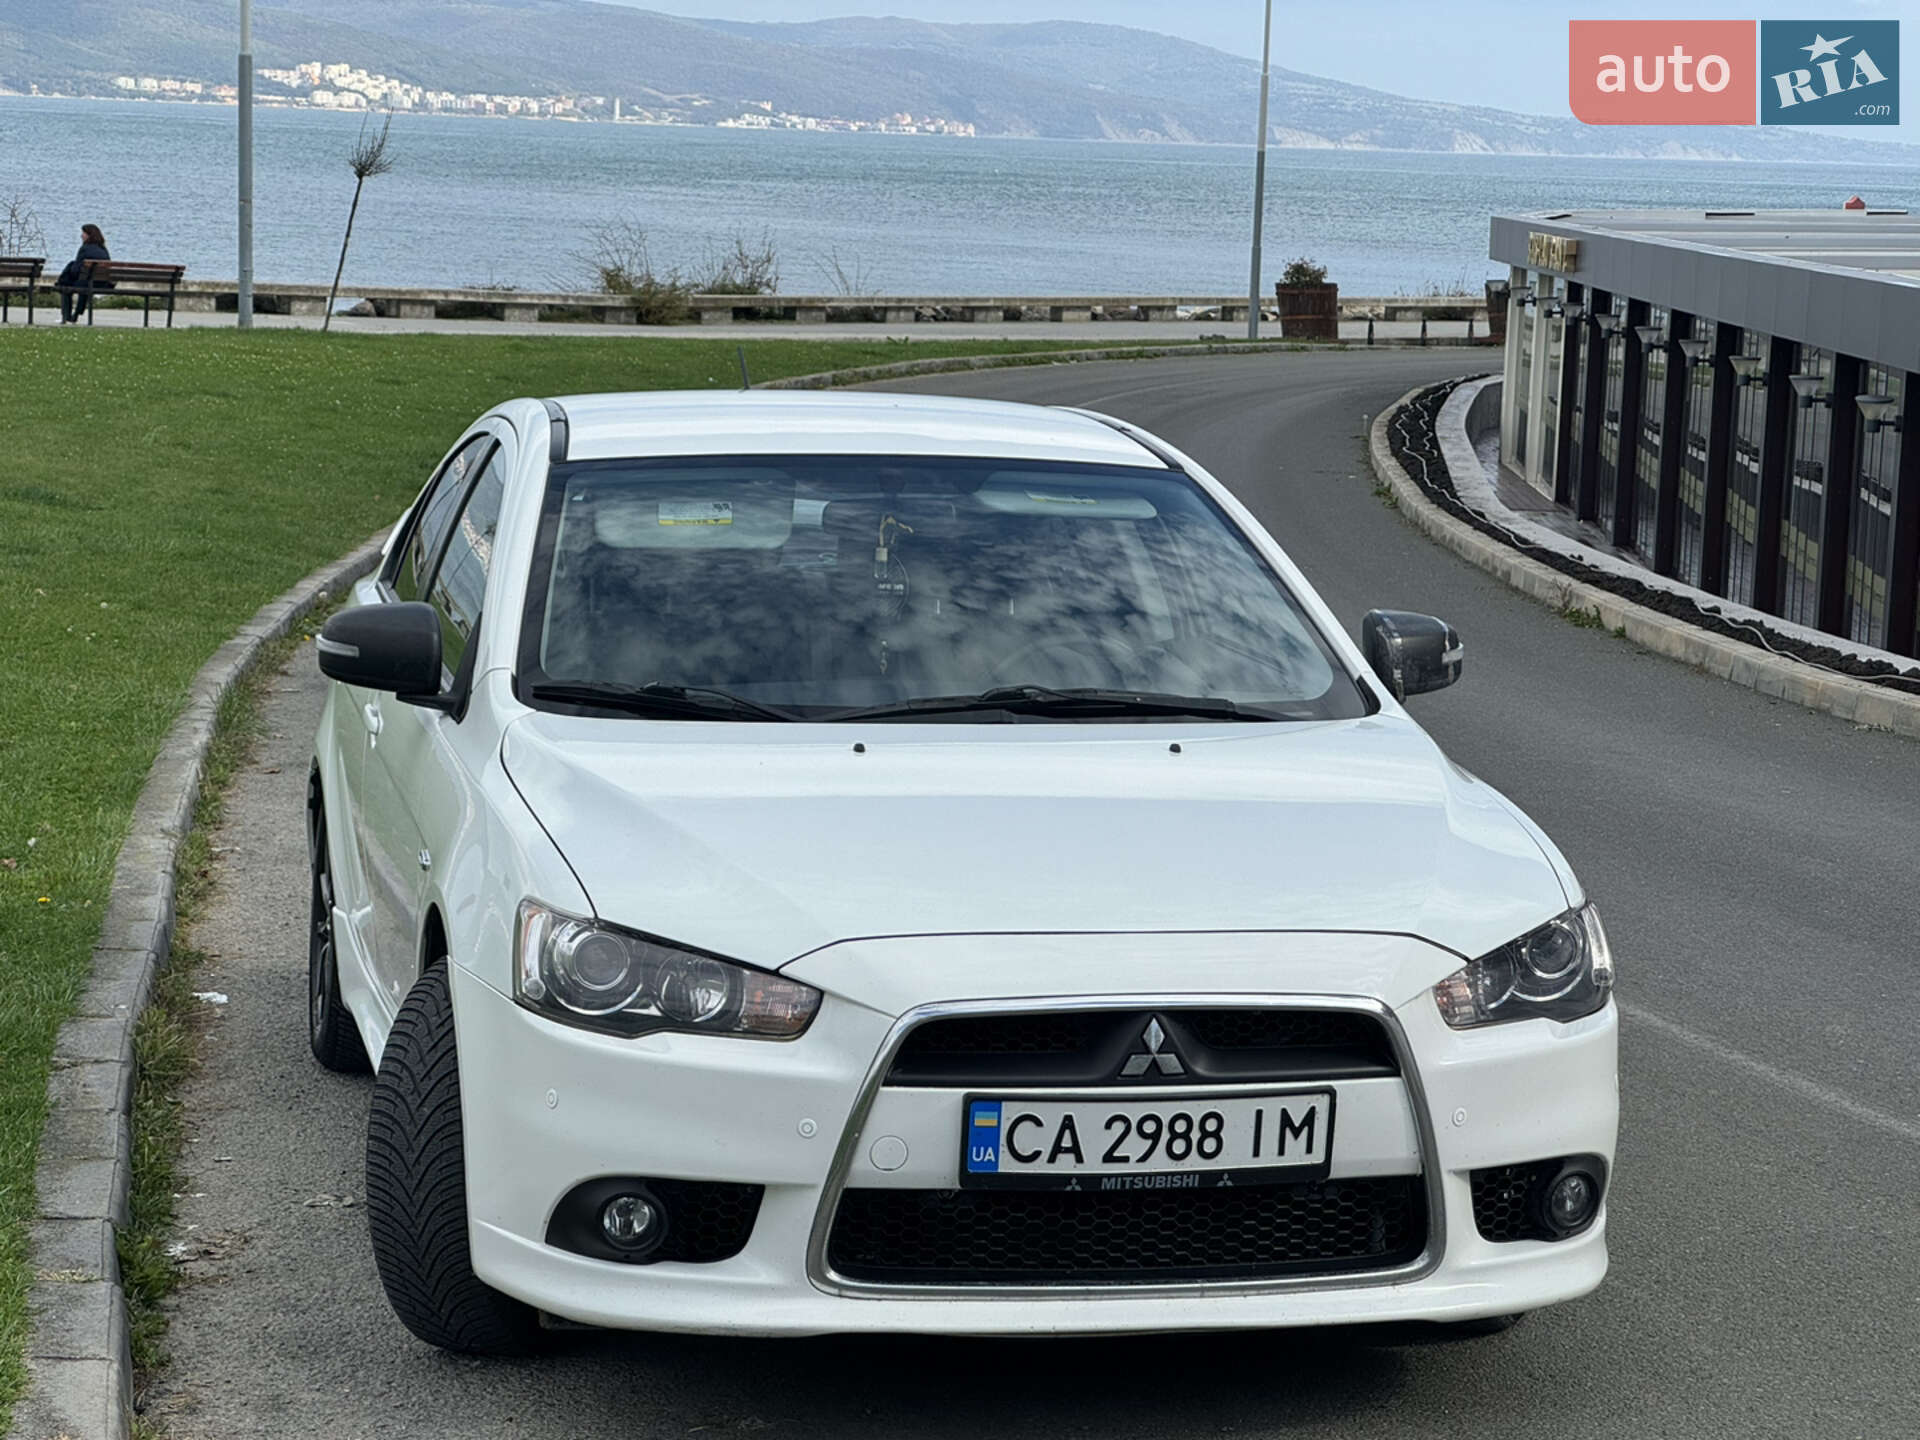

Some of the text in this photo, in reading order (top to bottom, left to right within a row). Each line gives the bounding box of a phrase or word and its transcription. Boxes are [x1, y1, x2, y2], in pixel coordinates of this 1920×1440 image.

[1005, 1105, 1317, 1165] CA 2988 IM
[972, 1147, 996, 1162] UA
[1101, 1174, 1200, 1190] MITSUBISHI
